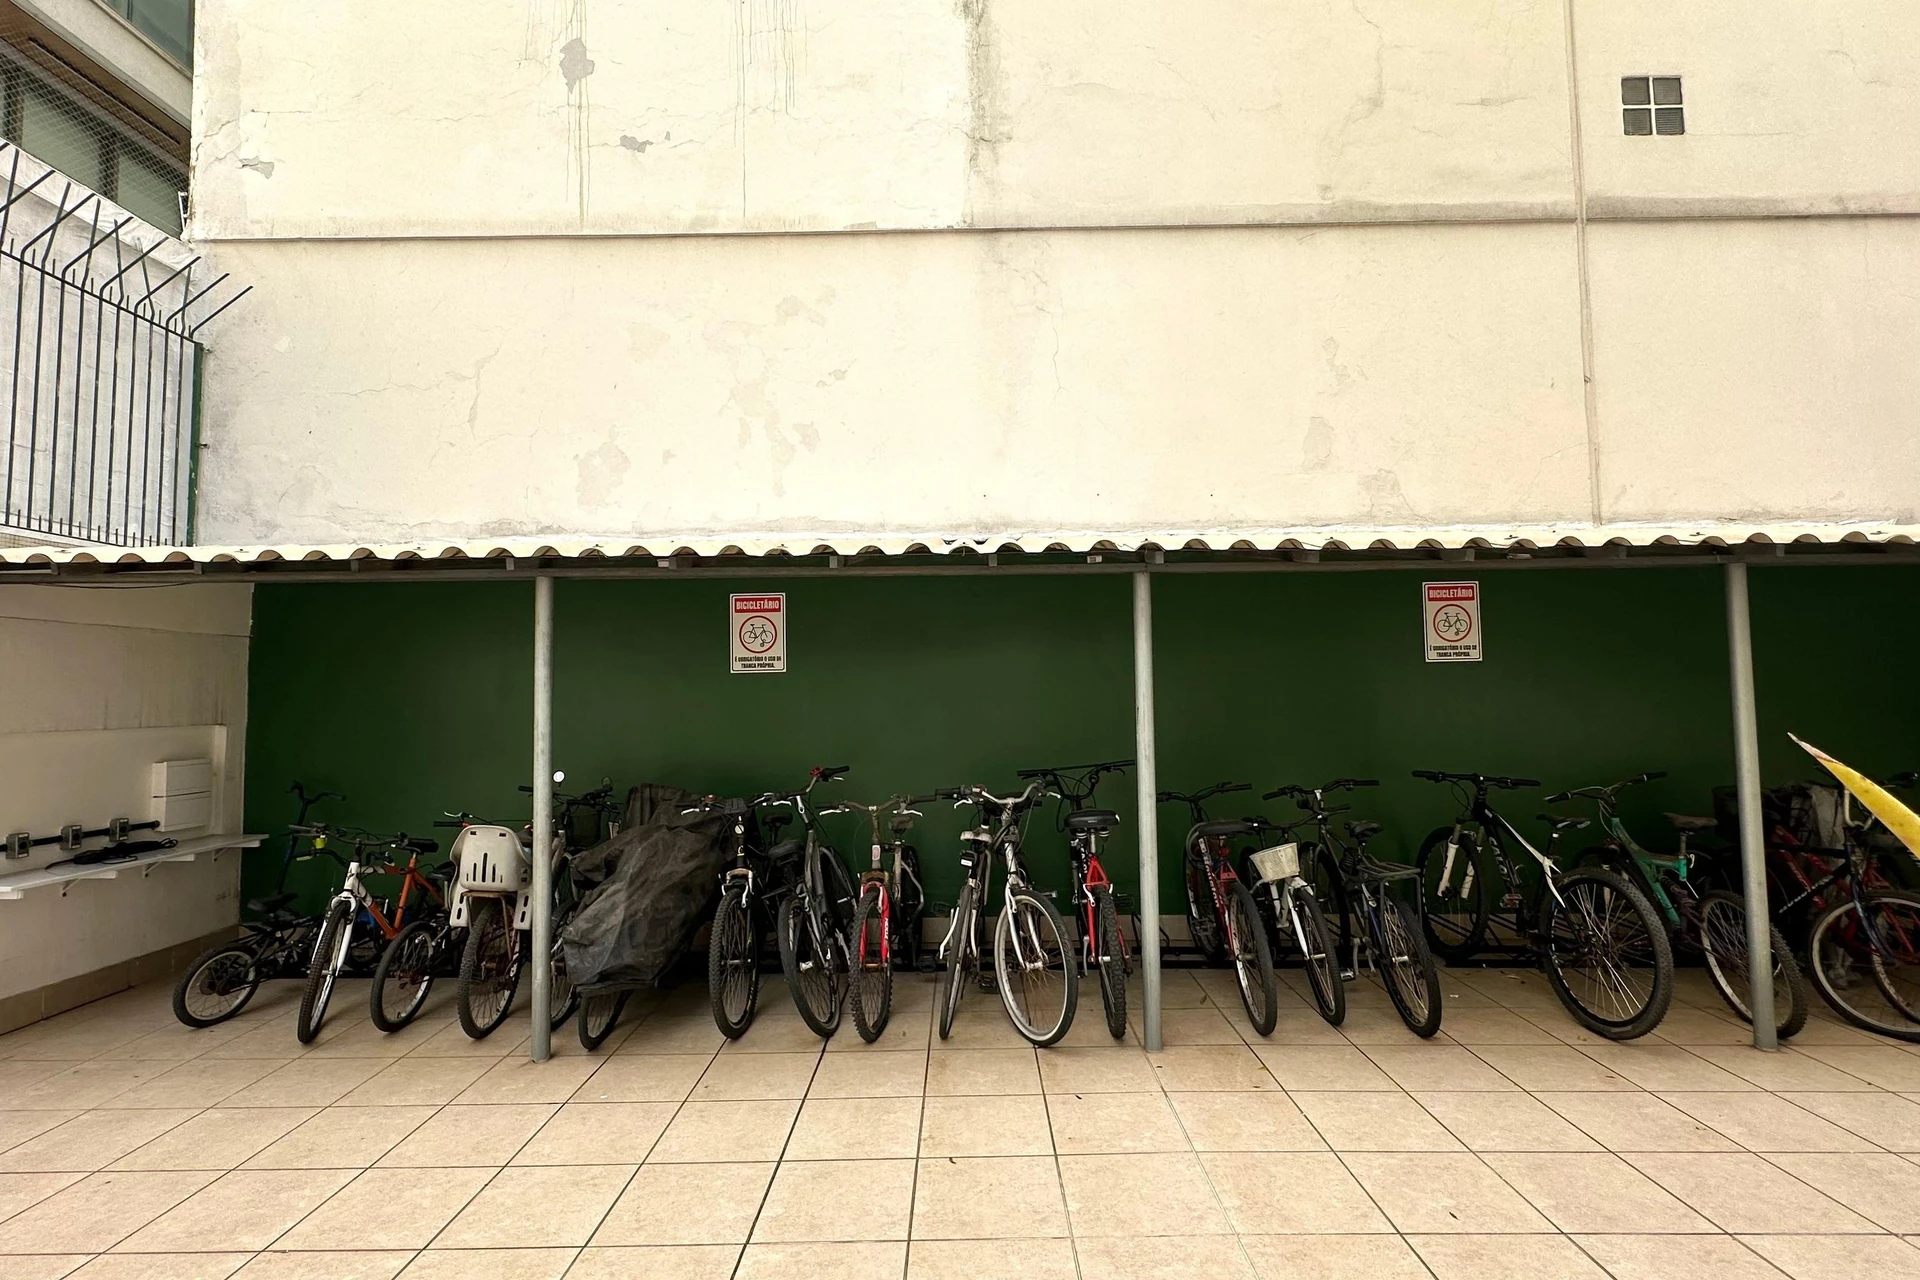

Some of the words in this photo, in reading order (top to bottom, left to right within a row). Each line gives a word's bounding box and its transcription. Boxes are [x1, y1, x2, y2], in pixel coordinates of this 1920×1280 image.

[1429, 587, 1473, 598] BICICLETÁRIO
[736, 599, 780, 610] BICICLETÁRIO
[1488, 836, 1511, 882] CALOI
